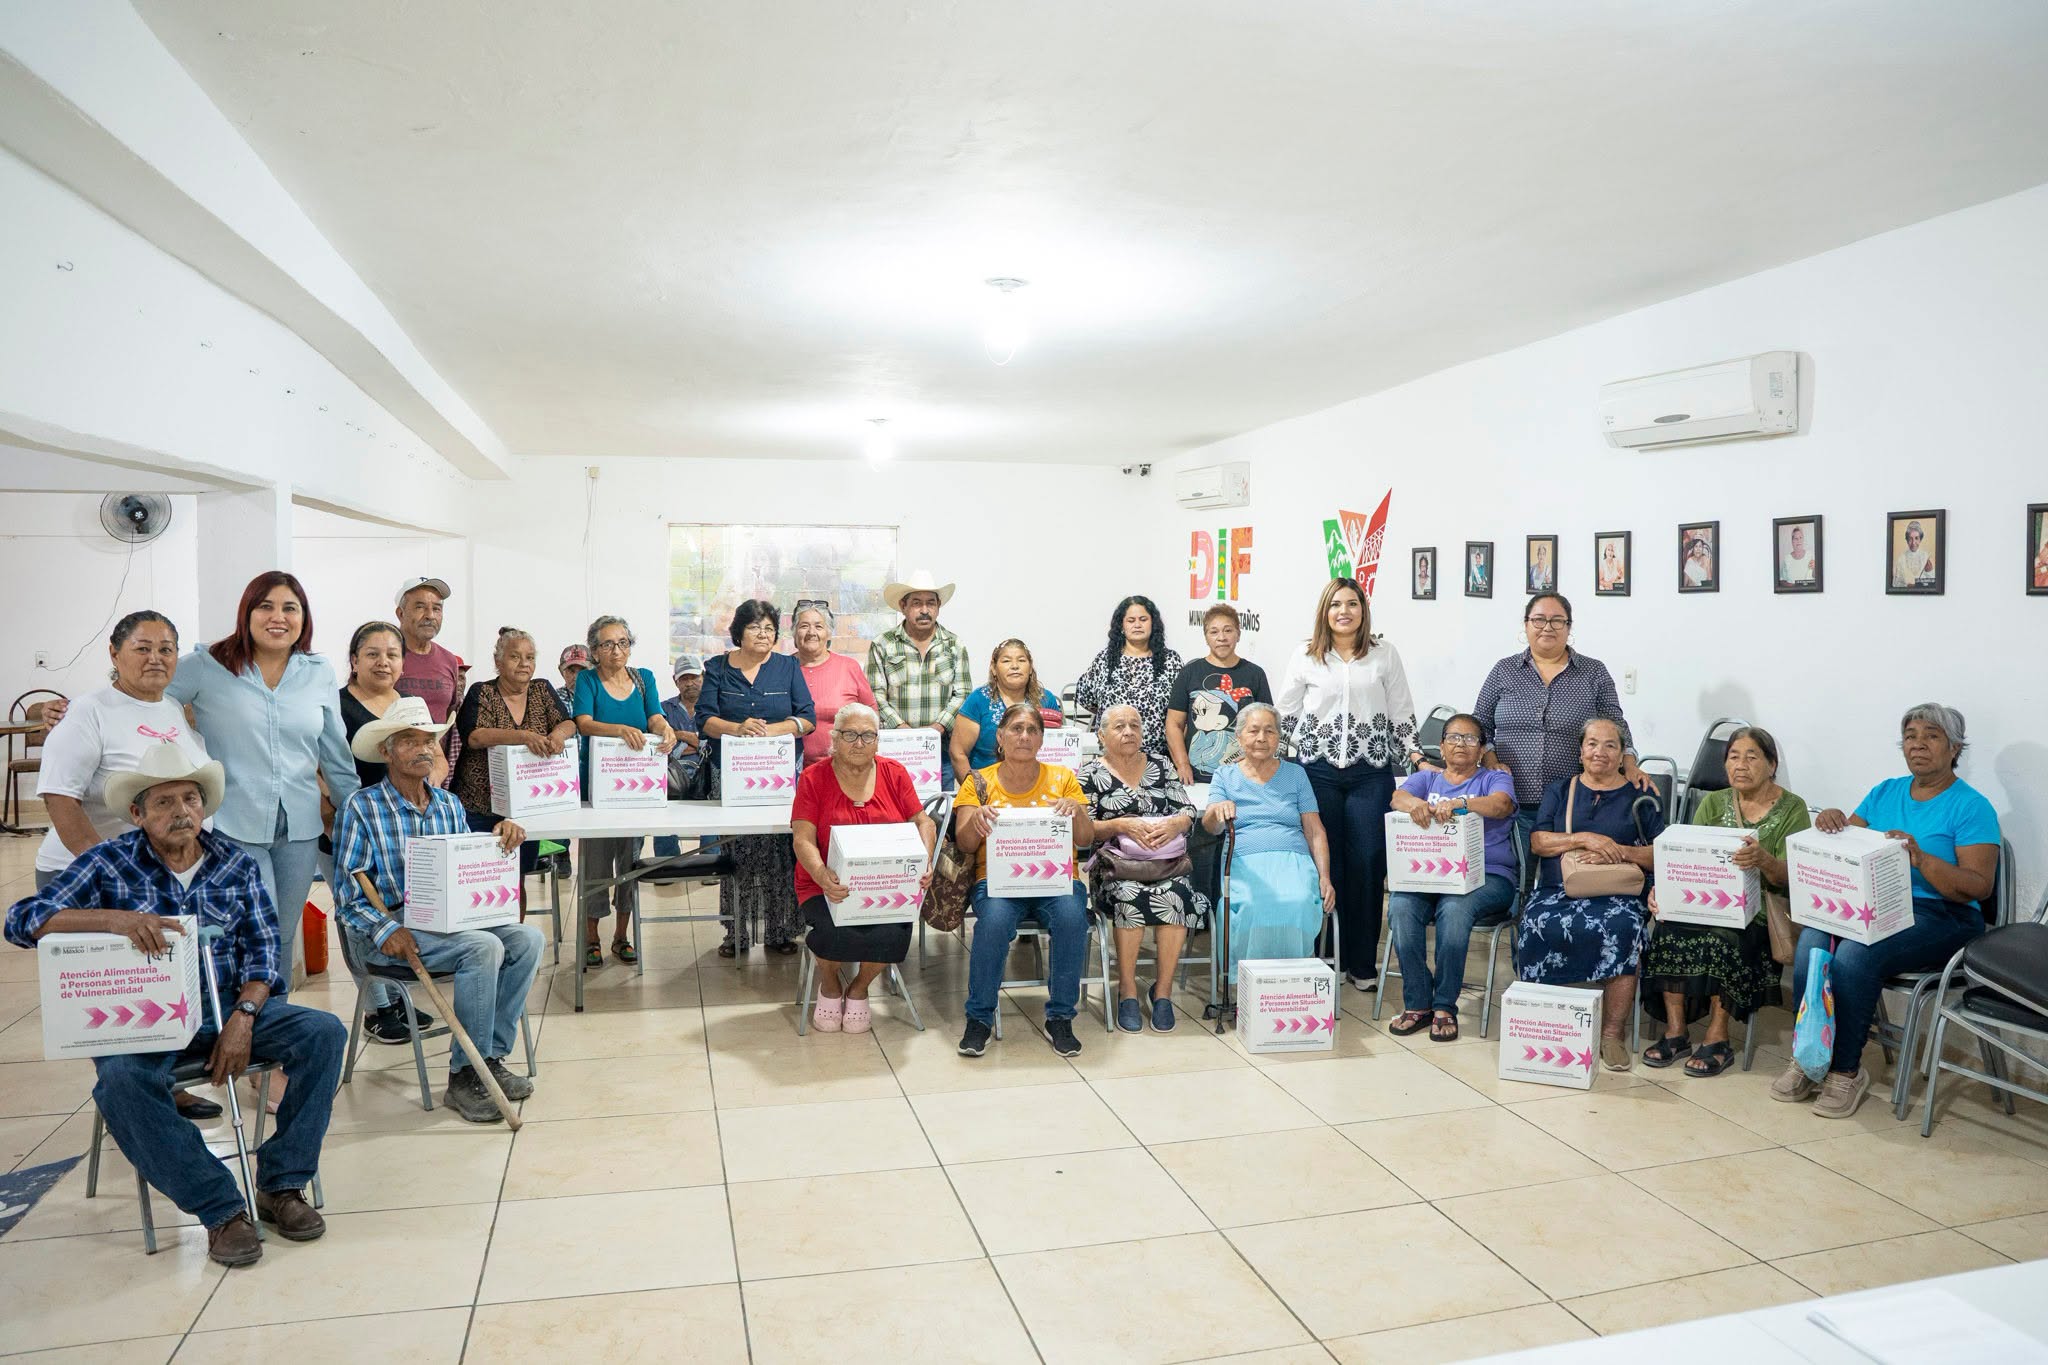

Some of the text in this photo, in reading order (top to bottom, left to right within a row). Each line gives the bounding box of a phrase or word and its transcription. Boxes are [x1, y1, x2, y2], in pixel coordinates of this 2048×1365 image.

[1189, 527, 1253, 601] DIF
[1239, 608, 1260, 633] TAÑOS
[1051, 825, 1070, 838] 37
[1443, 824, 1458, 835] 23
[60, 966, 158, 980] Atención Alimentaria
[68, 978, 112, 988] Personas
[128, 974, 171, 984] Situación
[61, 985, 143, 999] de Vulnerabilidad
[1509, 1018, 1573, 1030] Atención Alimentaria
[1574, 1011, 1592, 1028] 97
[1515, 1025, 1542, 1033] Personas
[1553, 1029, 1581, 1037] Situación
[1518, 1033, 1562, 1042] Vulnerabilidad
